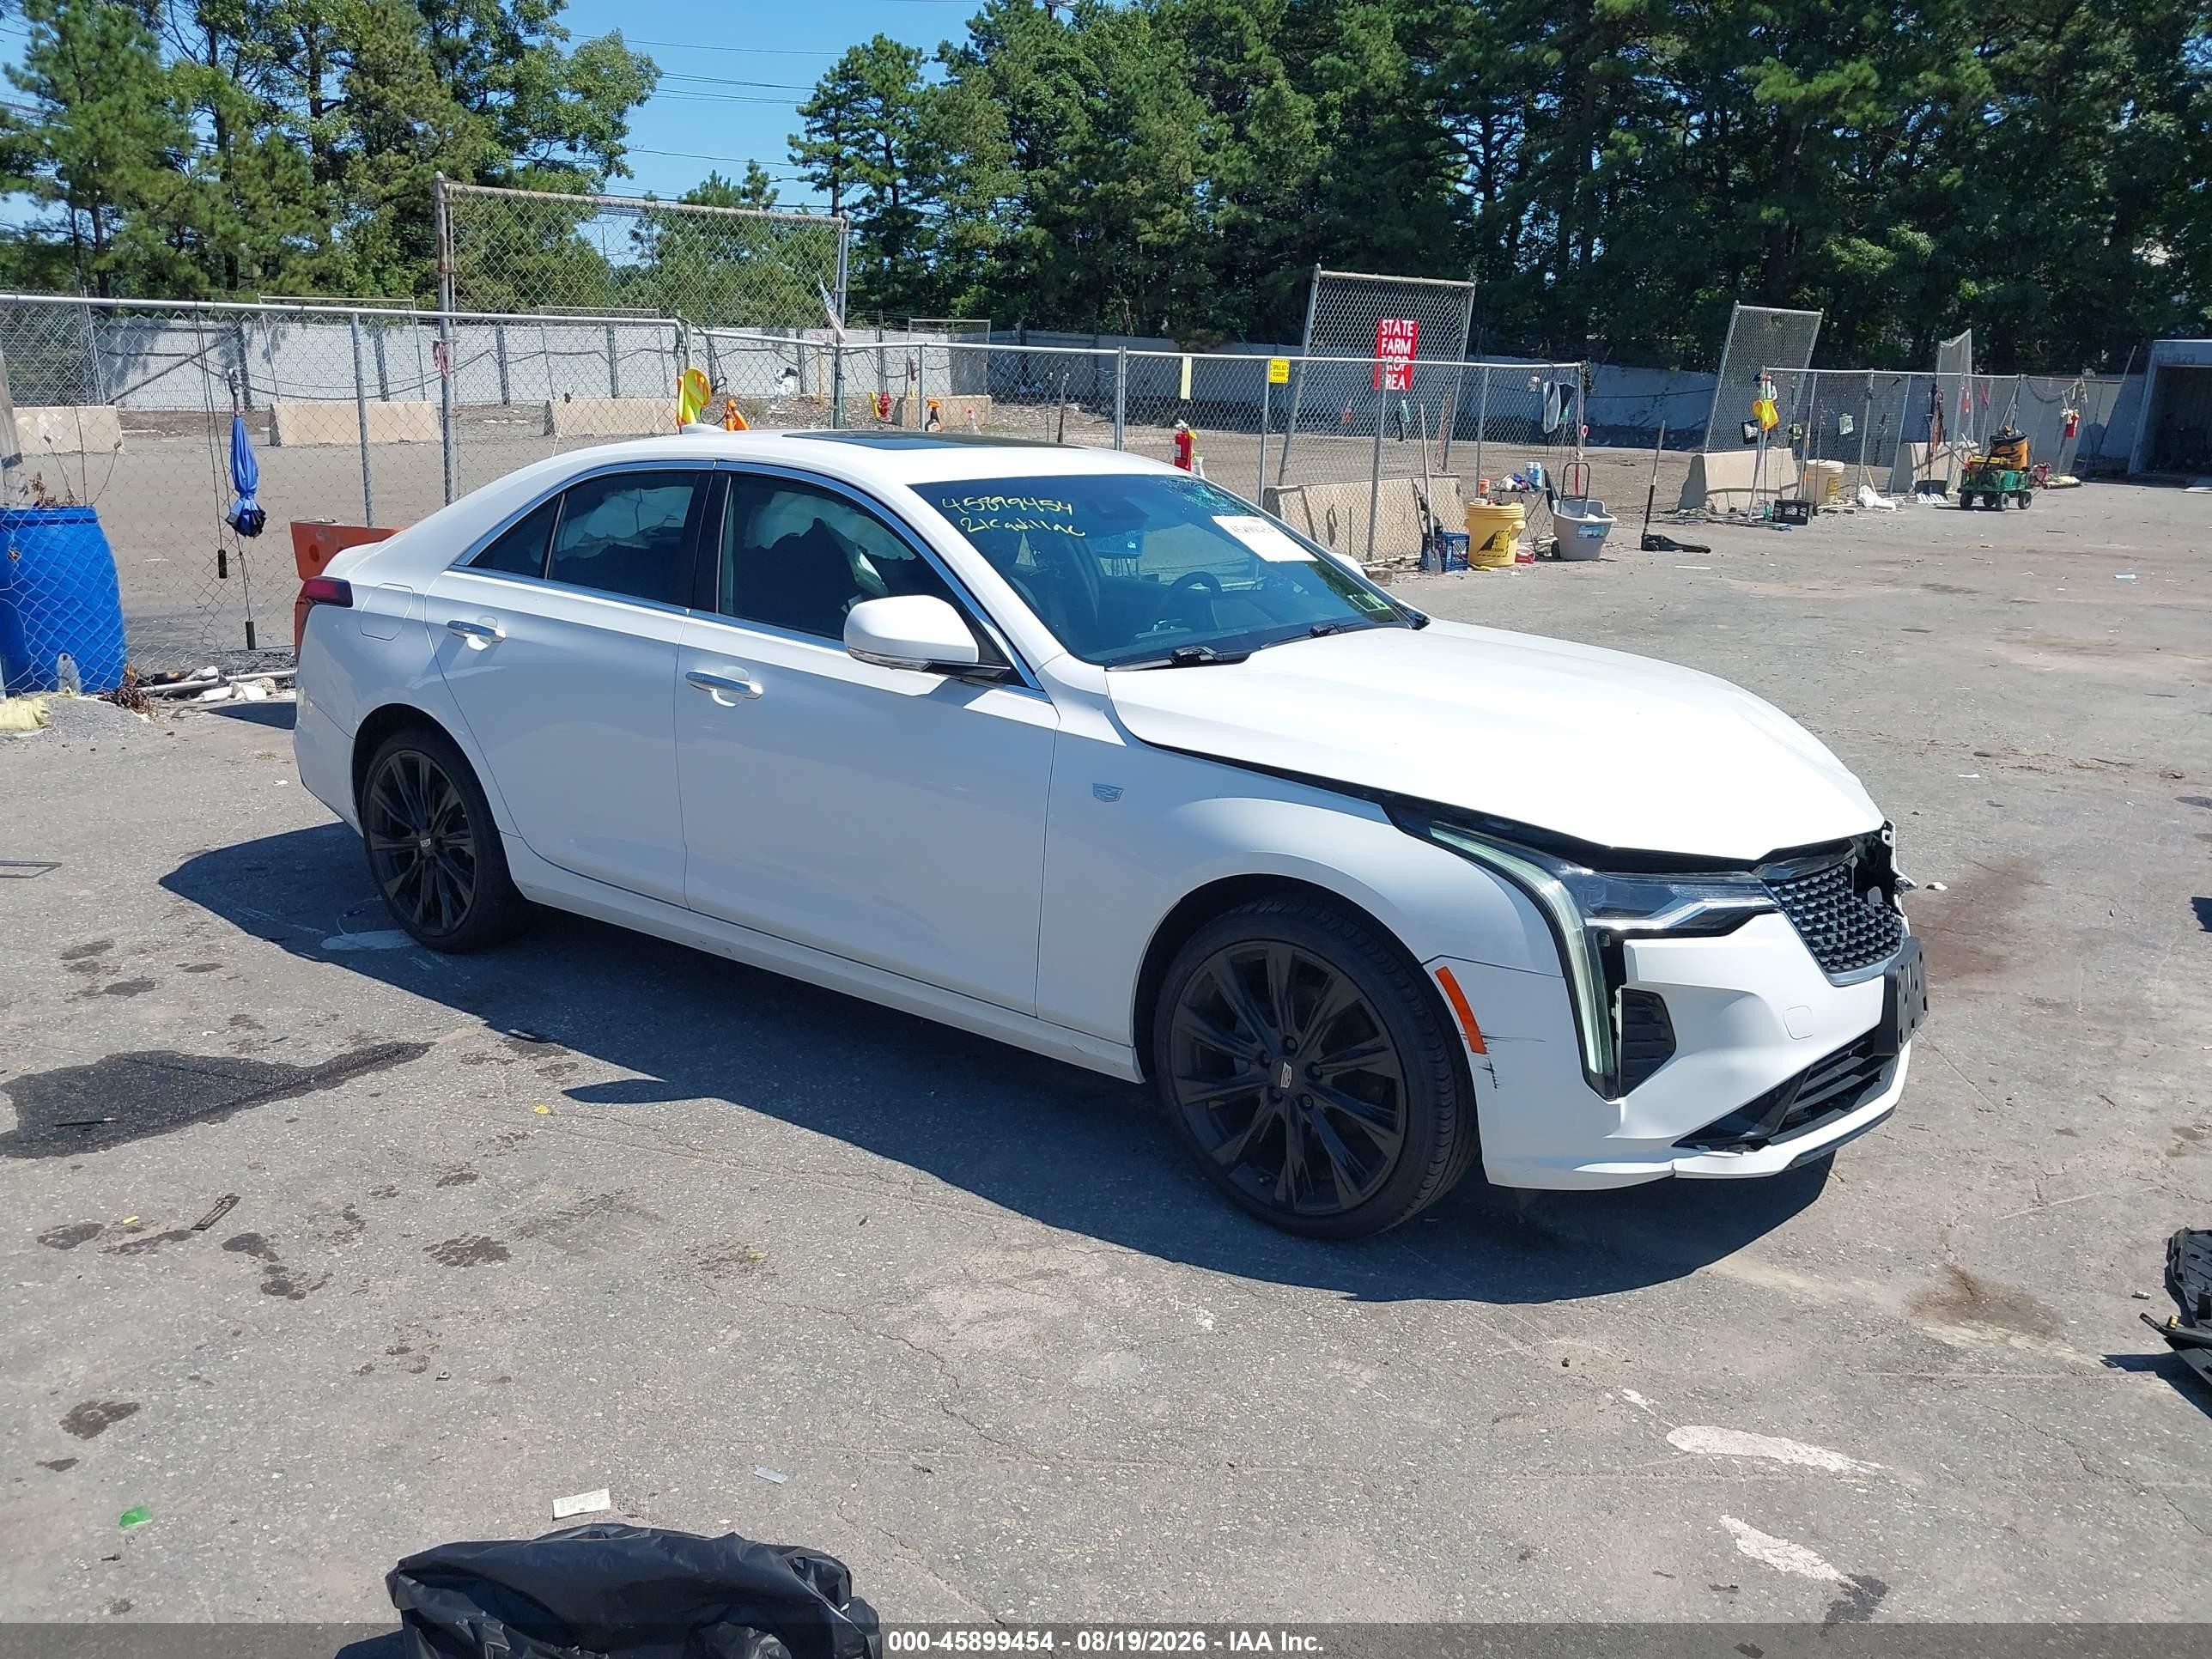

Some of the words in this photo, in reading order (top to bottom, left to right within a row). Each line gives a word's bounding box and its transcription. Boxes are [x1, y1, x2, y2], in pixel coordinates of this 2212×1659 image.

[1381, 319, 1414, 337] STATE
[1380, 337, 1411, 355] FARM
[1381, 356, 1409, 371] ROP
[1382, 374, 1407, 390] REA
[941, 495, 1073, 515] 45899454
